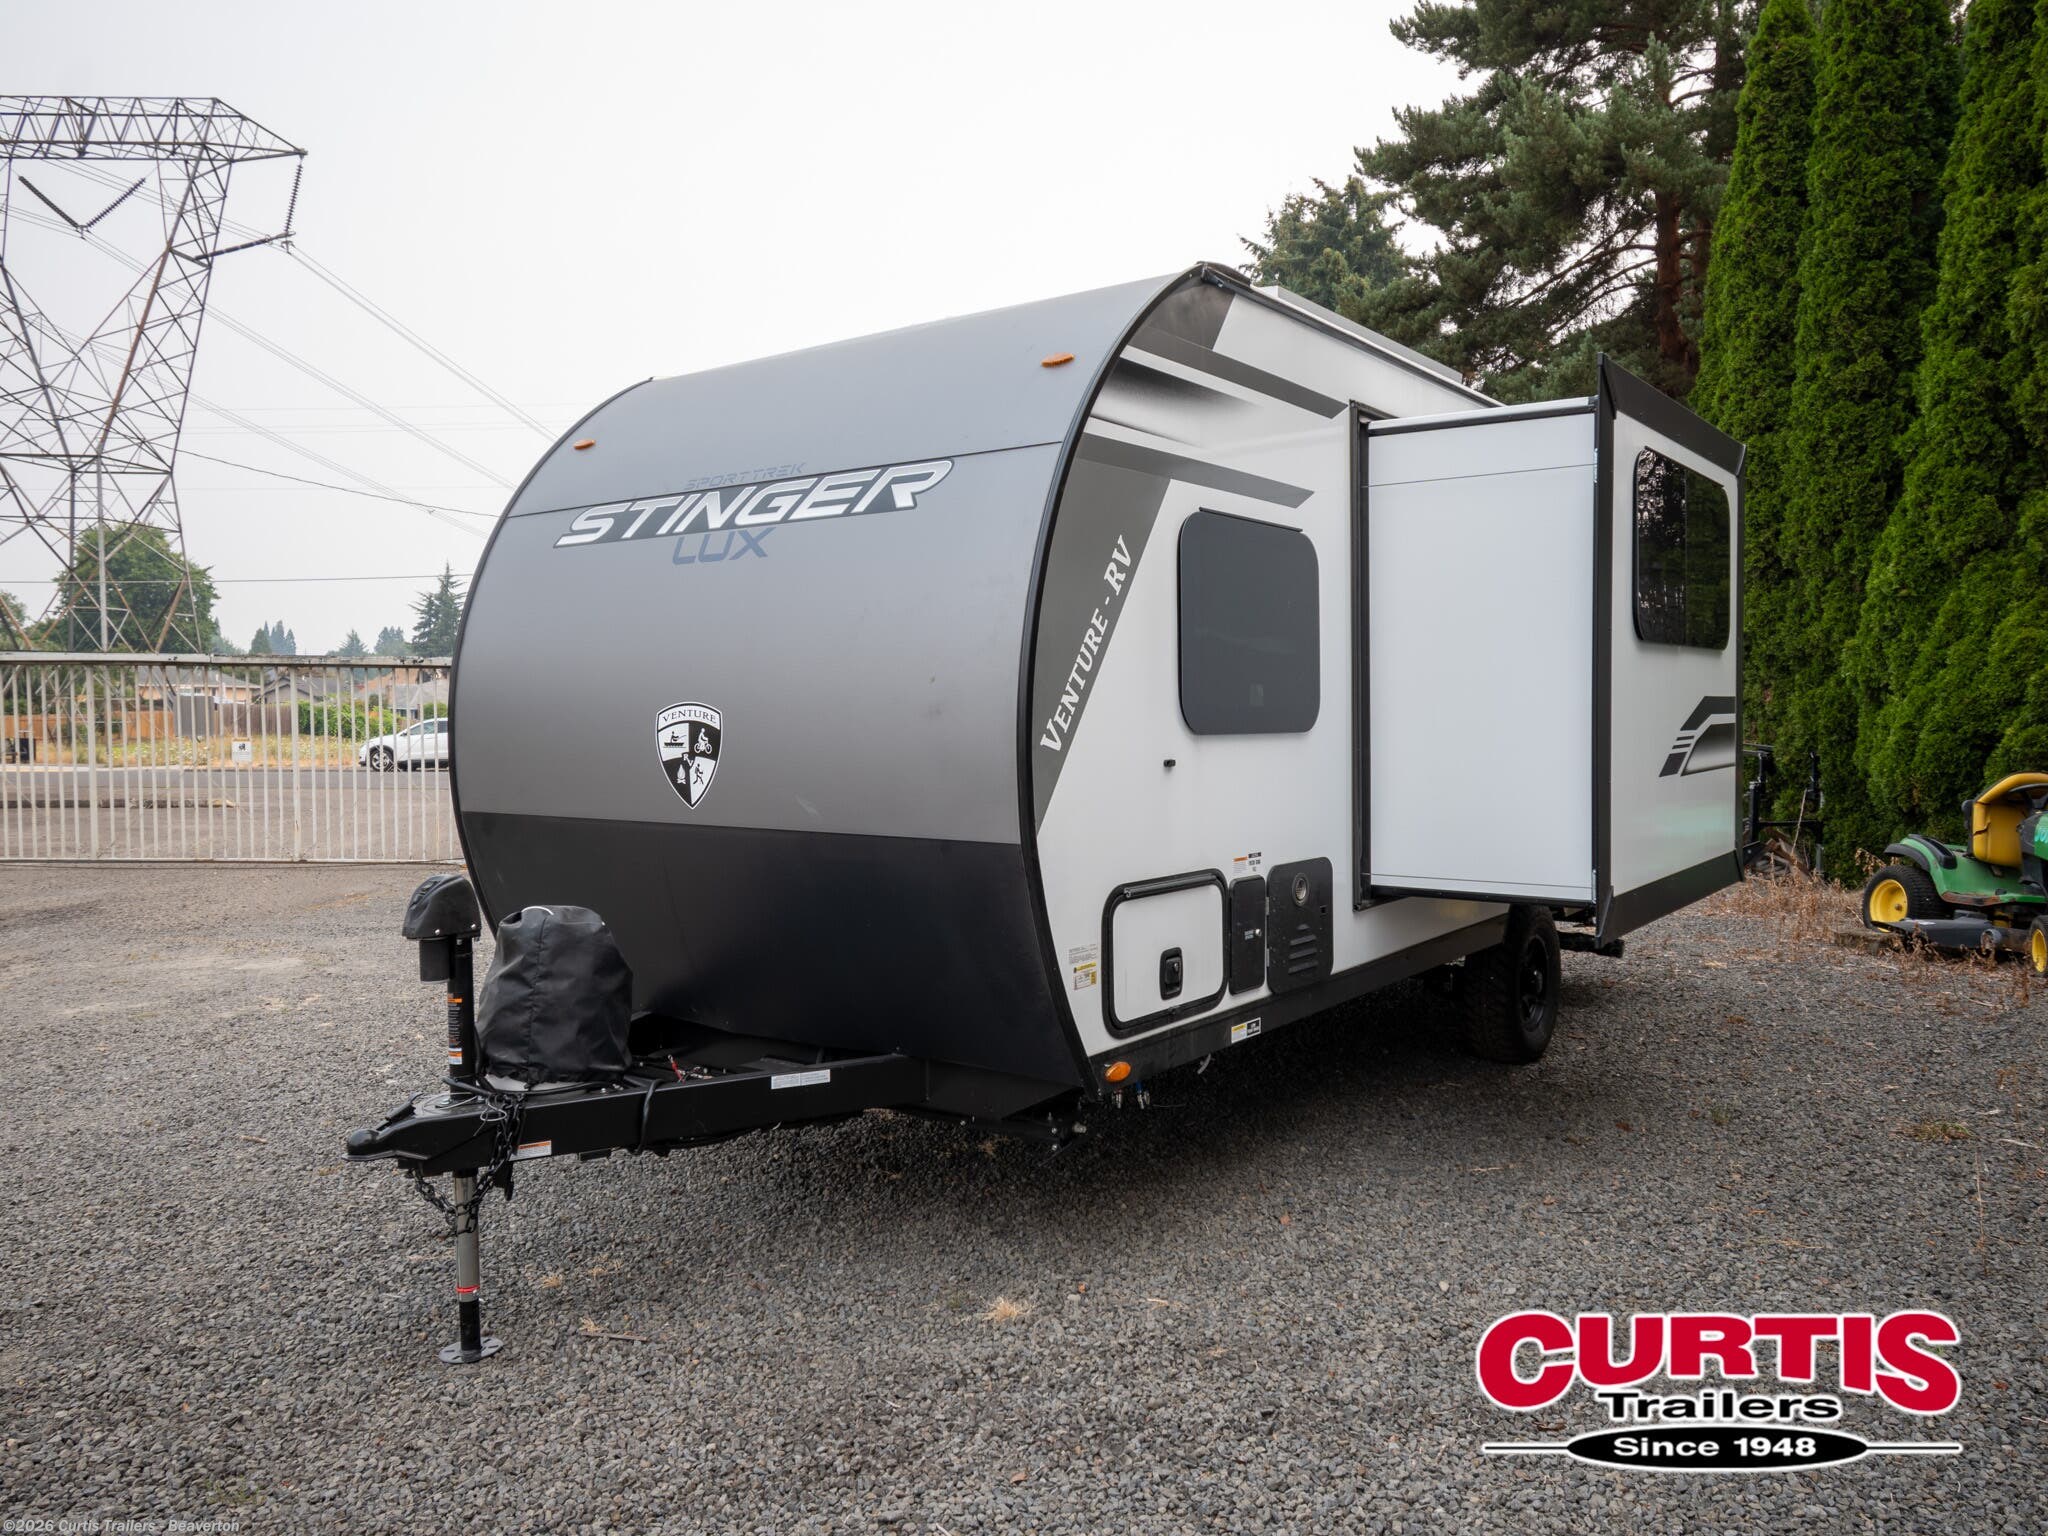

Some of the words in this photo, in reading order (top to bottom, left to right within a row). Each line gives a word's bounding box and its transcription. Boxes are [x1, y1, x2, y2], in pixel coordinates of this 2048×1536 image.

[553, 457, 955, 548] STINGER
[672, 527, 776, 565] LUX
[1040, 608, 1108, 751] VENTURE
[1104, 534, 1132, 596] RV
[662, 710, 717, 723] VENTURE
